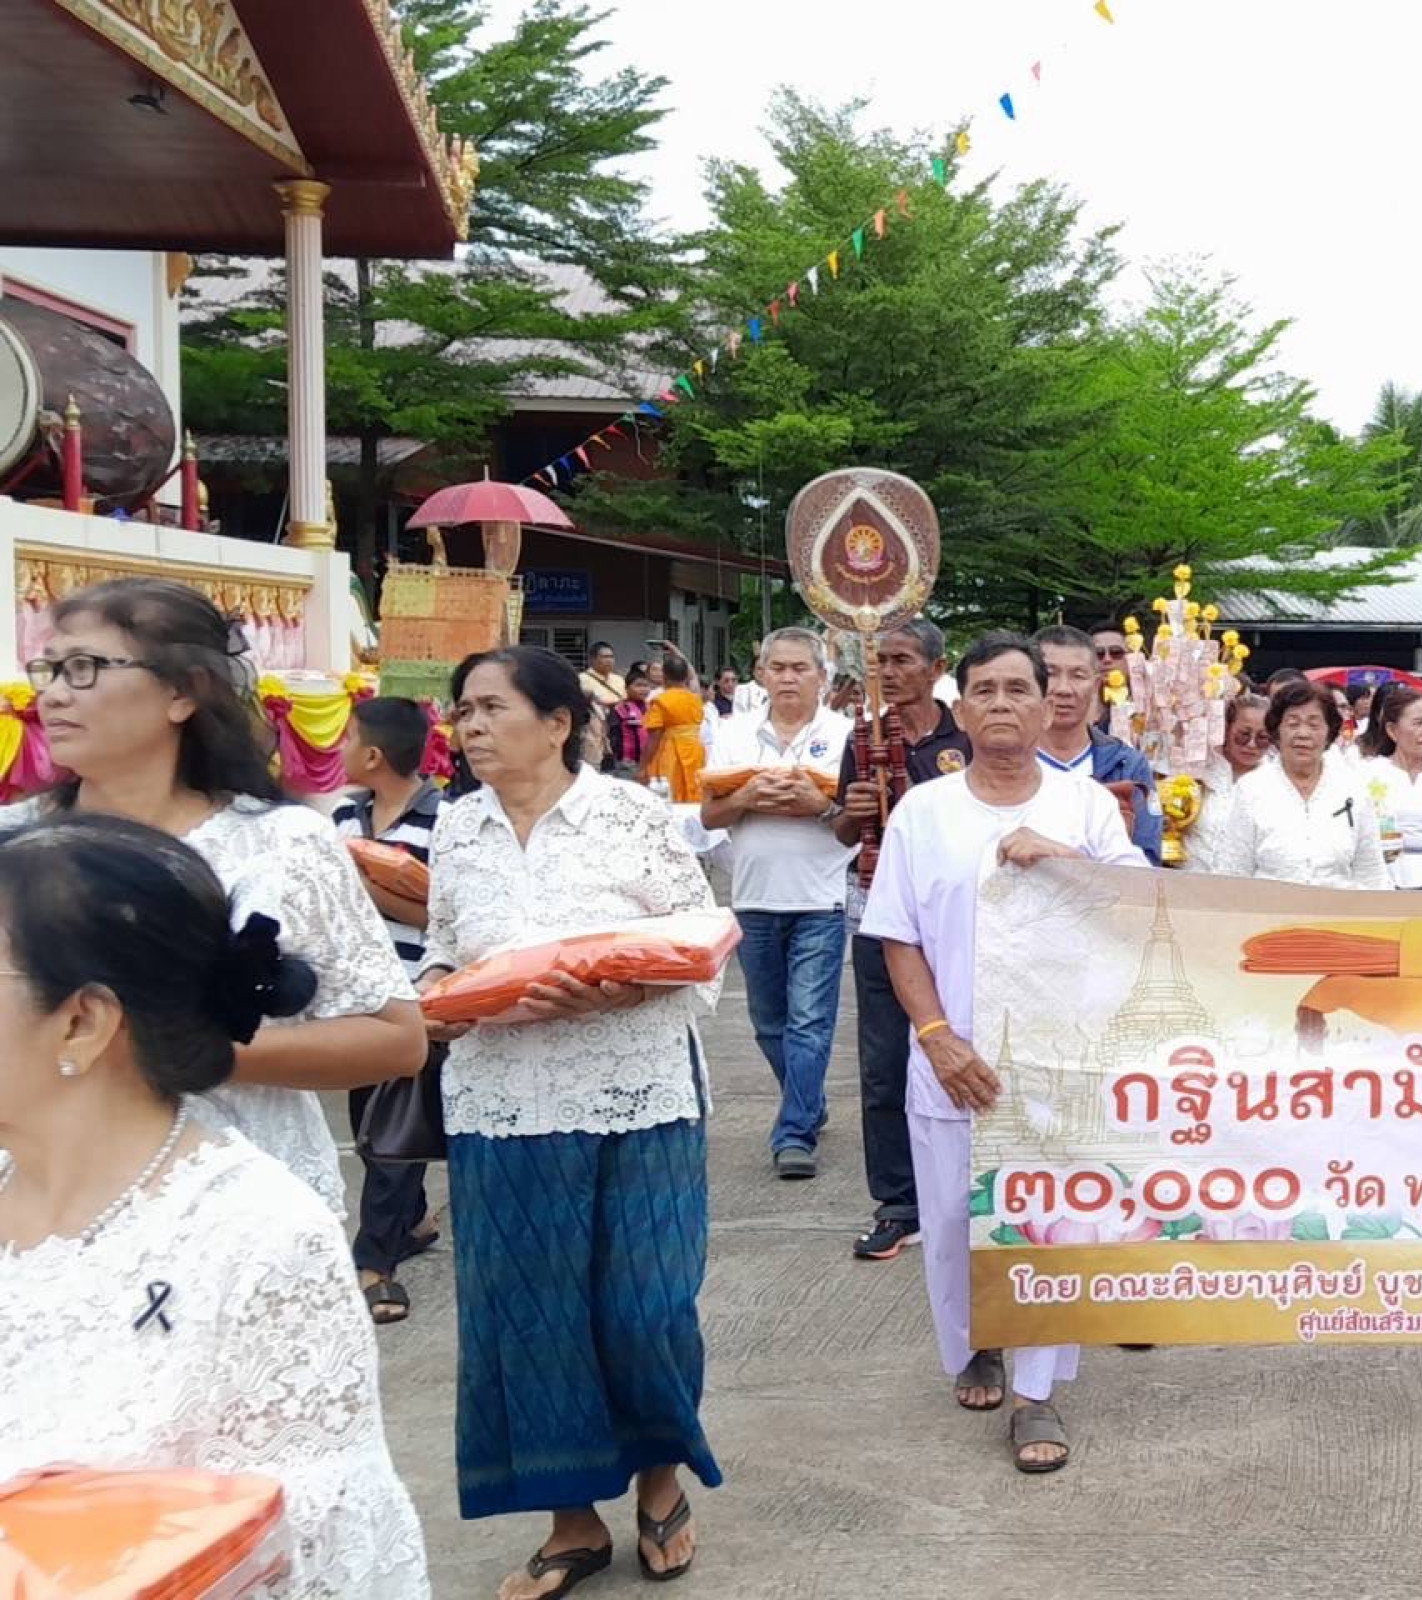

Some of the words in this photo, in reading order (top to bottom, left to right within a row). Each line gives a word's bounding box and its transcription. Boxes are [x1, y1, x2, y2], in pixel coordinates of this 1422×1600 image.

[1004, 1167, 1301, 1221] ๓๐,๐๐๐
[1325, 1159, 1385, 1207] วัด
[1013, 1267, 1078, 1300] โดย
[1092, 1262, 1362, 1304] คณะศิษยานุศิษย์
